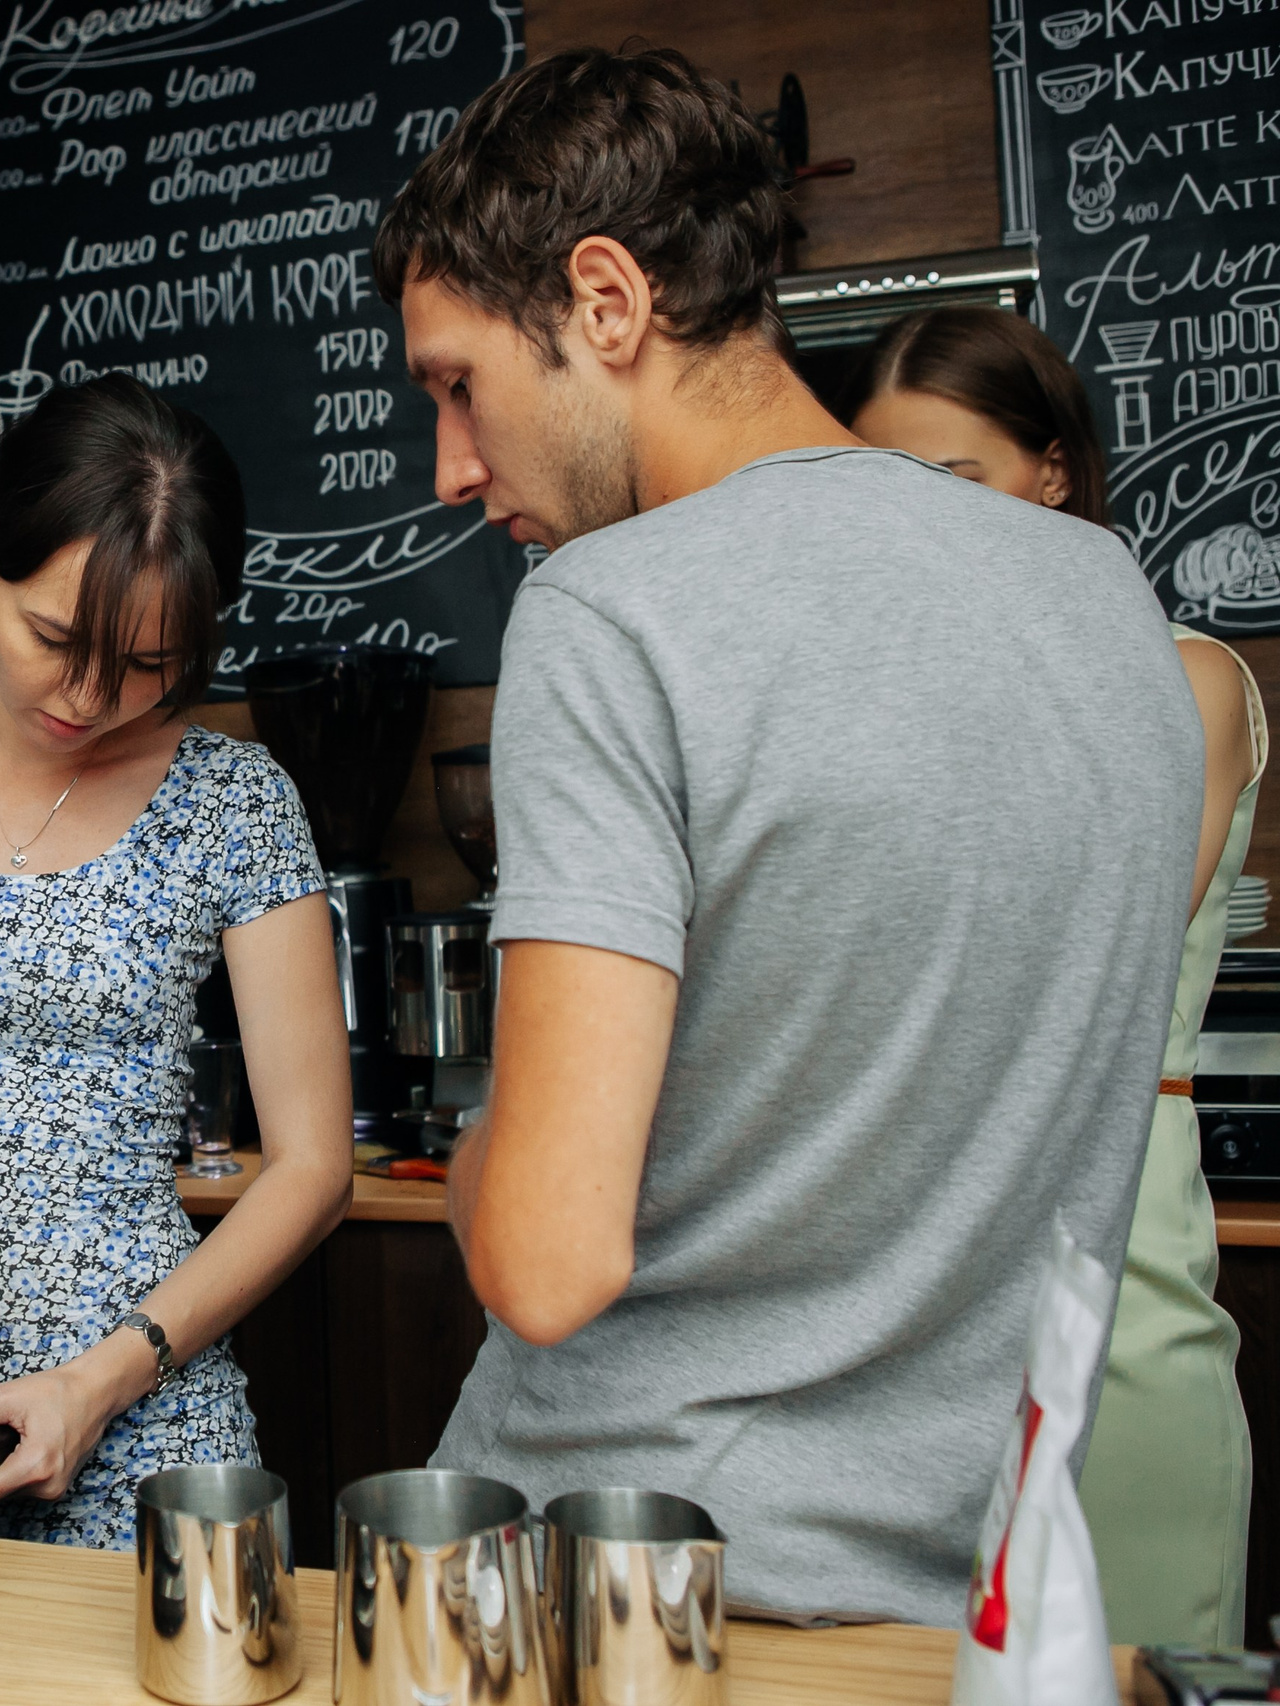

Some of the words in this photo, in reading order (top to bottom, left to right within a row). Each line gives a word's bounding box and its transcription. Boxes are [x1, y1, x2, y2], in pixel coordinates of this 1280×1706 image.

[41, 87, 153, 131] Флет
[165, 65, 256, 108] Уайт
[388, 16, 459, 65] 120
[51, 139, 127, 187] Раф
[145, 91, 378, 164] классический
[394, 105, 460, 157] 170
[149, 141, 333, 205] авторский
[55, 234, 158, 281] Мокко
[199, 193, 381, 253] шоколадом
[1121, 201, 1160, 226] 400
[60, 255, 254, 349] ХОЛОДНЫЙ
[271, 248, 377, 326] КОФЕ
[1170, 306, 1280, 363] ПУРОВ
[1172, 360, 1280, 423] АЭРОП
